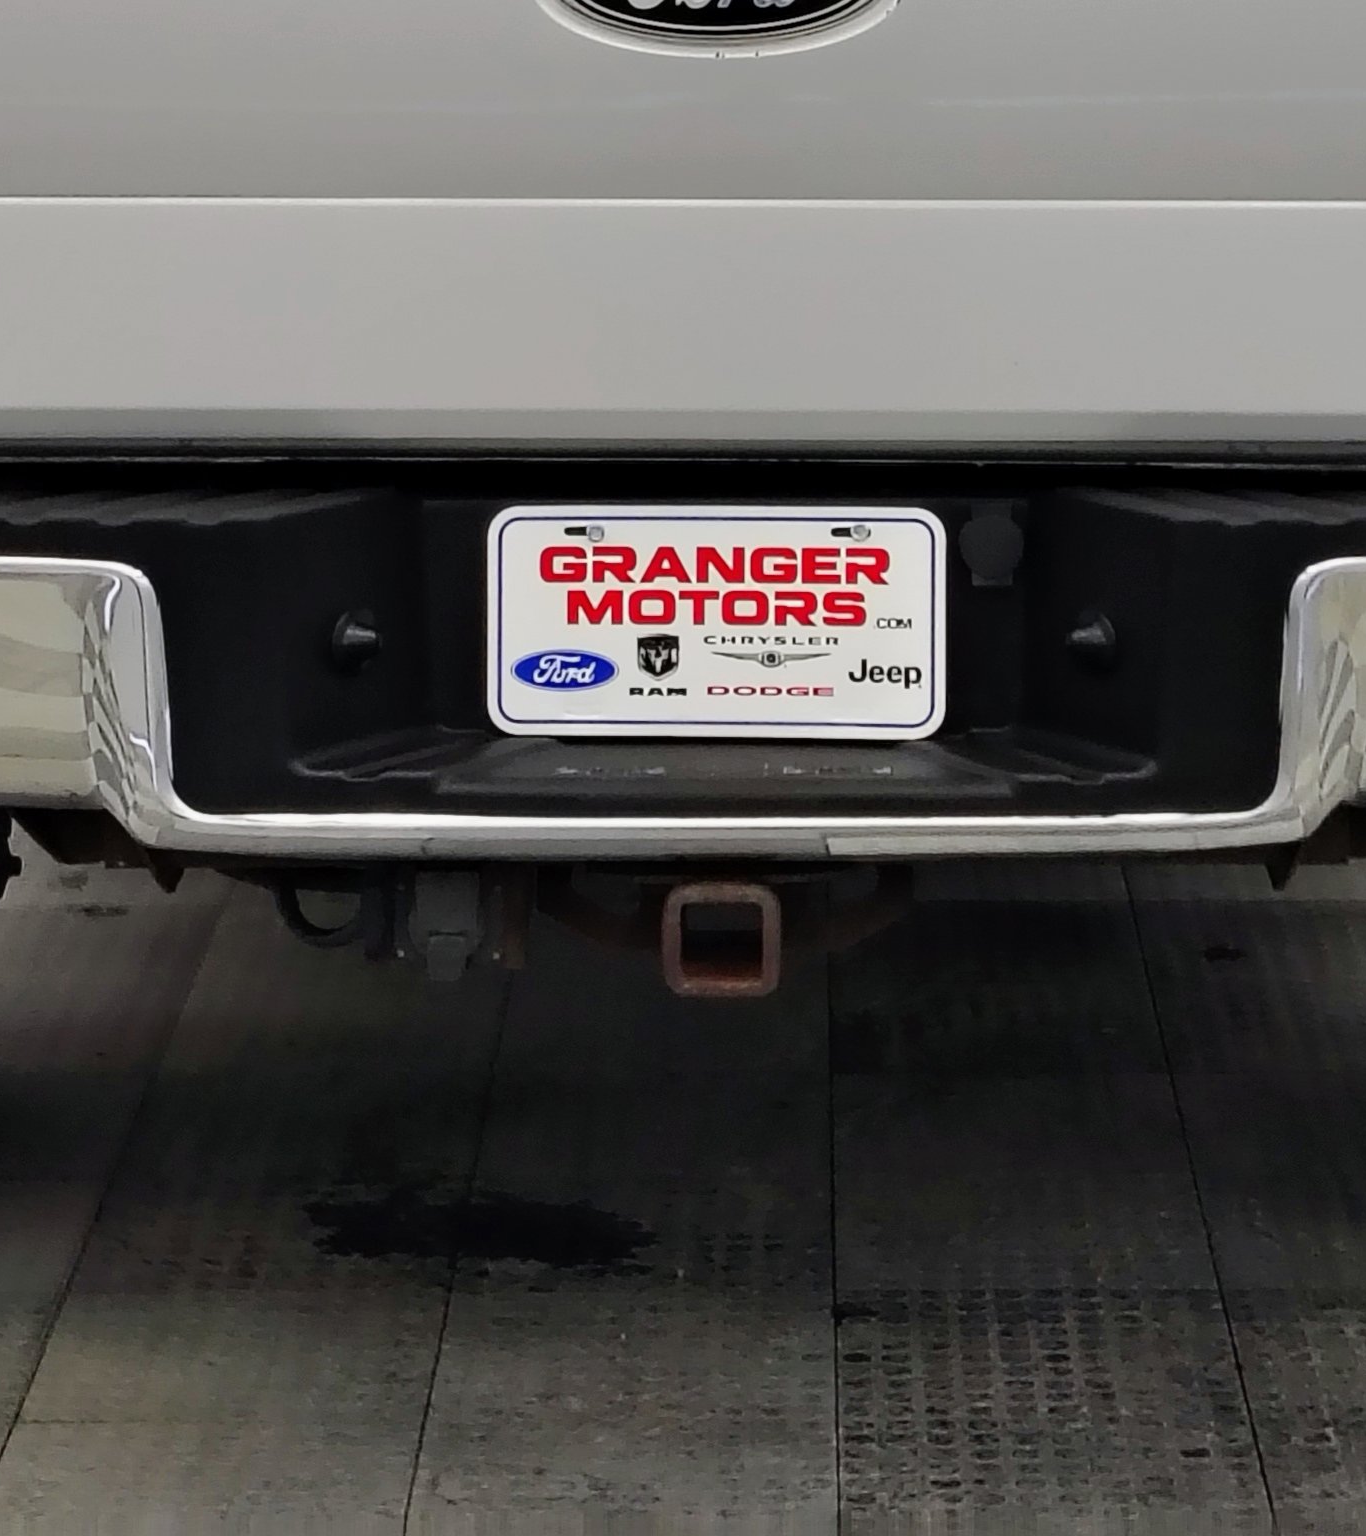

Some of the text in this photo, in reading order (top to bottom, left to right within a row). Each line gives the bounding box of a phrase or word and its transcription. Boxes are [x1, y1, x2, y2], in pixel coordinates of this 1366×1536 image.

[539, 546, 892, 585] GRANGER
[566, 589, 868, 628] MOTORS
[703, 635, 840, 646] CHRYSLER
[532, 654, 597, 685] Ford
[848, 659, 923, 690] Jeep
[628, 687, 688, 697] RAM
[706, 686, 835, 696] DODGE
